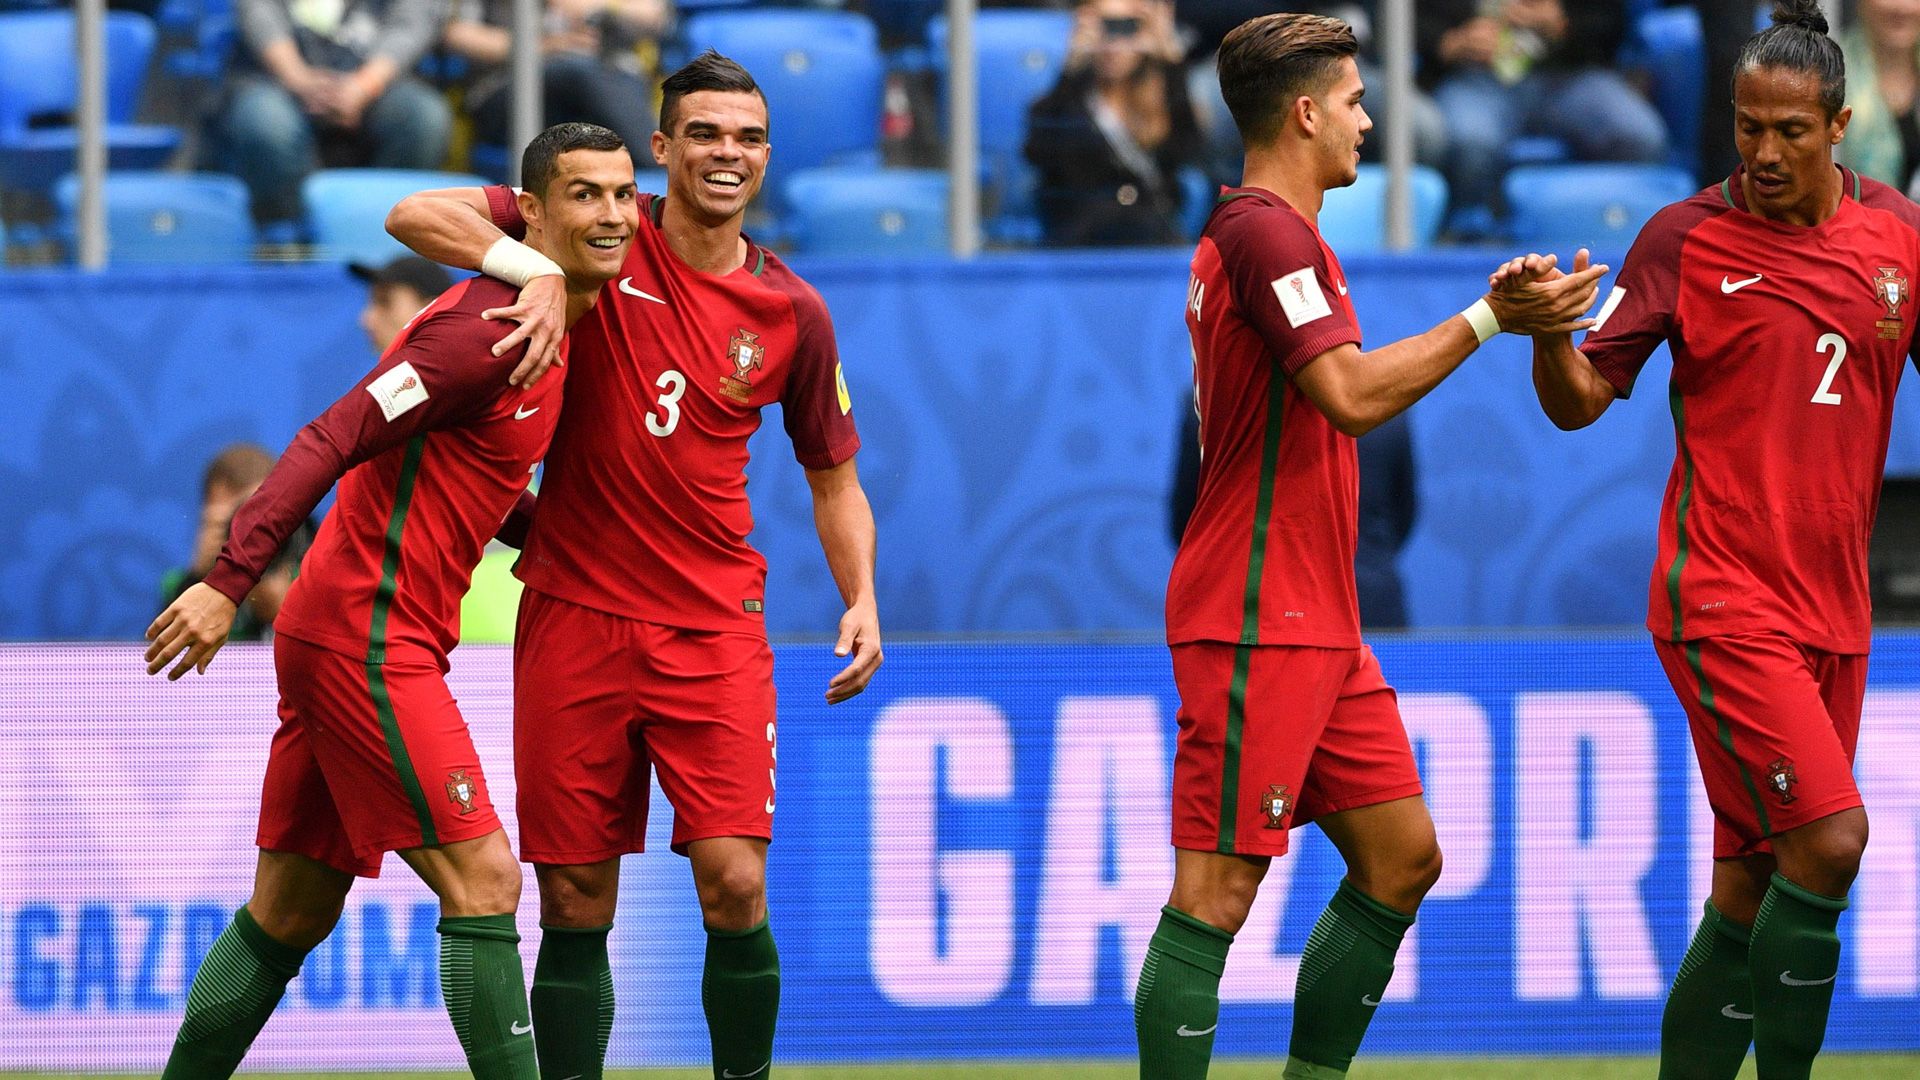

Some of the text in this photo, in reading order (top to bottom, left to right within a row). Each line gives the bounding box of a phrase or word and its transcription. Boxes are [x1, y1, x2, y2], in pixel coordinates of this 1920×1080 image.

[645, 369, 687, 437] 3
[1810, 333, 1847, 405] 2
[870, 692, 1920, 1007] GAPR
[14, 902, 440, 1010] GAZPOM
